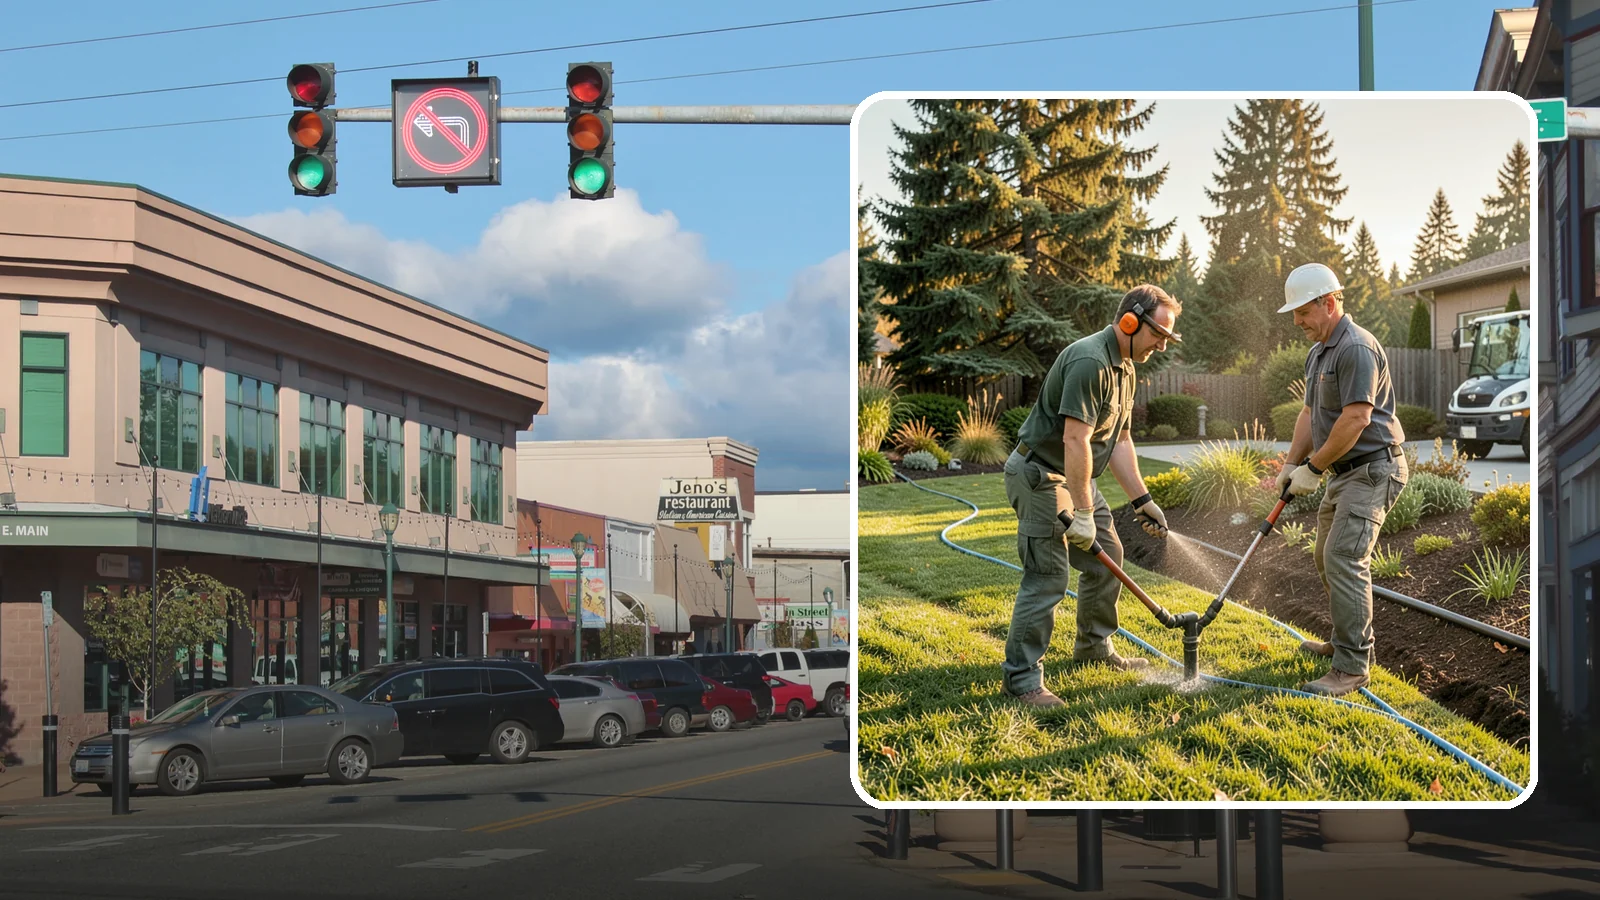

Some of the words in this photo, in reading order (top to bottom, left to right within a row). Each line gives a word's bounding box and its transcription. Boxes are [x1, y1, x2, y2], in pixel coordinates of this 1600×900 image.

[669, 480, 727, 494] Jeno's
[665, 496, 731, 509] restaurant
[658, 510, 681, 519] Italian
[686, 510, 714, 519] American
[715, 510, 737, 519] Cuisine
[2, 525, 13, 536] E.
[15, 525, 49, 536] MAIN
[797, 608, 828, 617] Street
[790, 619, 823, 627] lass
